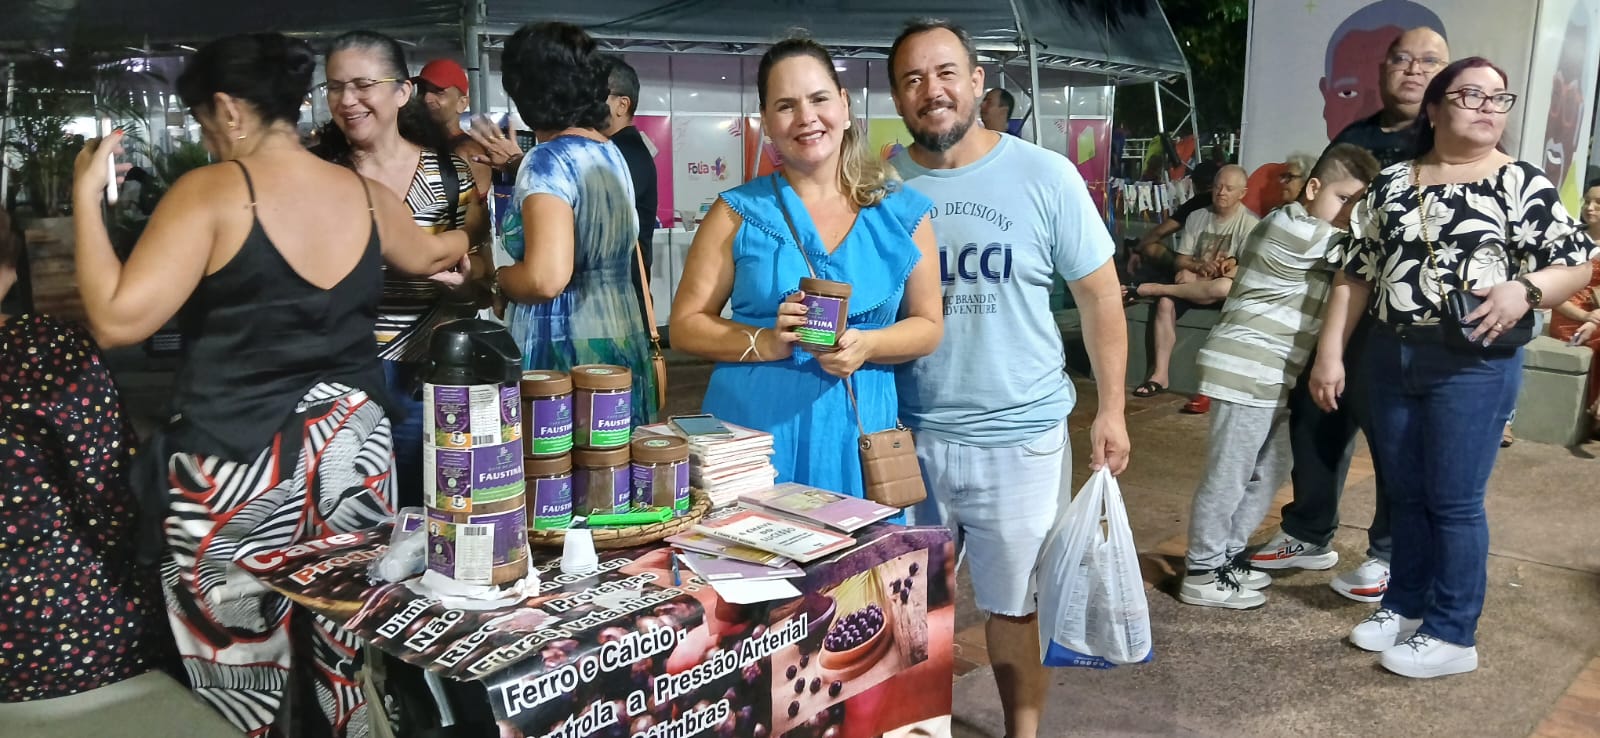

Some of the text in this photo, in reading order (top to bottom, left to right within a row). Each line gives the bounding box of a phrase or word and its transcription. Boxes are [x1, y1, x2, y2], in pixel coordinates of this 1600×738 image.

[945, 201, 1013, 232] DECISIONS
[939, 242, 1012, 286] LCCI
[944, 303, 997, 316] DVENTURE
[955, 293, 986, 305] BRAND
[987, 293, 997, 303] IN
[479, 465, 522, 483] FAUSTINA
[1277, 543, 1304, 557] FILA
[409, 610, 461, 648] Não
[505, 669, 575, 712] Ferro
[585, 659, 597, 678] e
[602, 628, 672, 670] Cálcio
[629, 693, 643, 712] a
[657, 652, 735, 699] Pressão
[742, 617, 807, 663] Arterial
